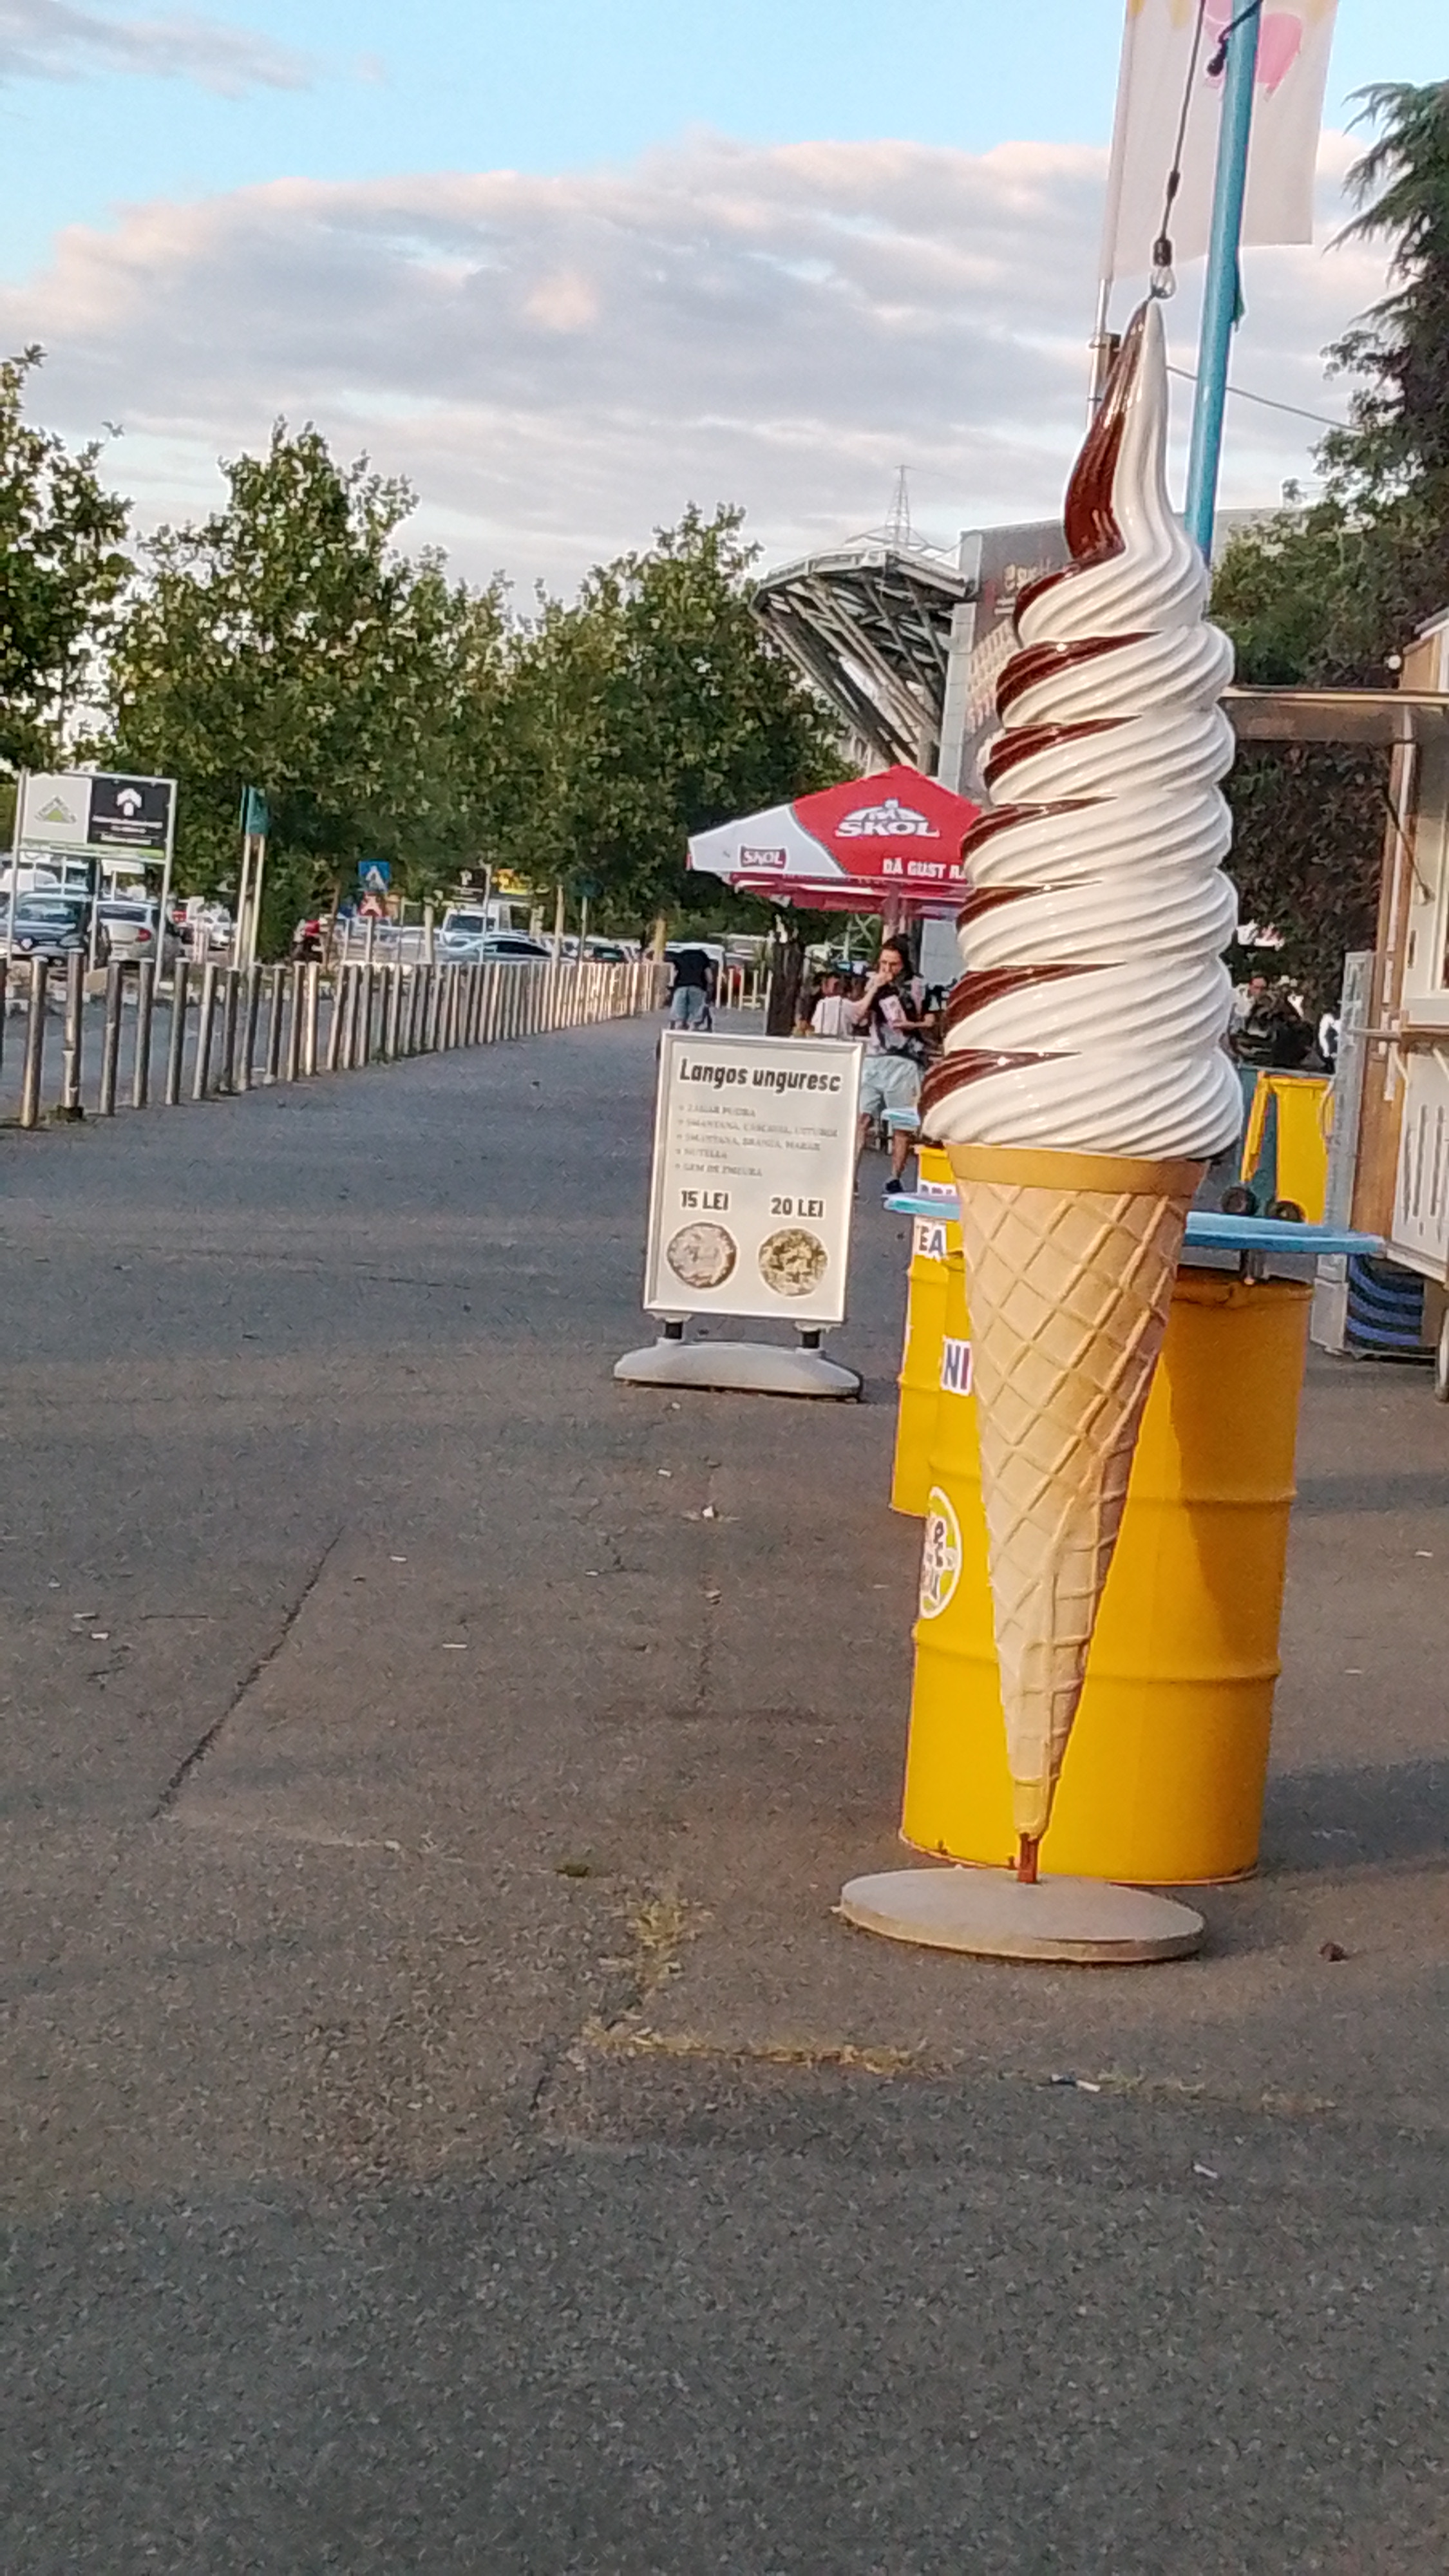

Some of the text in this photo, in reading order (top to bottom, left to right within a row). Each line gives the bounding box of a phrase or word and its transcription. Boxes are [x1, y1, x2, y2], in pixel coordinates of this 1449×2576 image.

[835, 821, 940, 838] SKOL
[743, 851, 784, 865] SKOL
[907, 860, 947, 879] GUST
[679, 1058, 841, 1094] Langos unguresc
[681, 1190, 729, 1210] 15 LEI
[771, 1197, 824, 1217] 20 LEI
